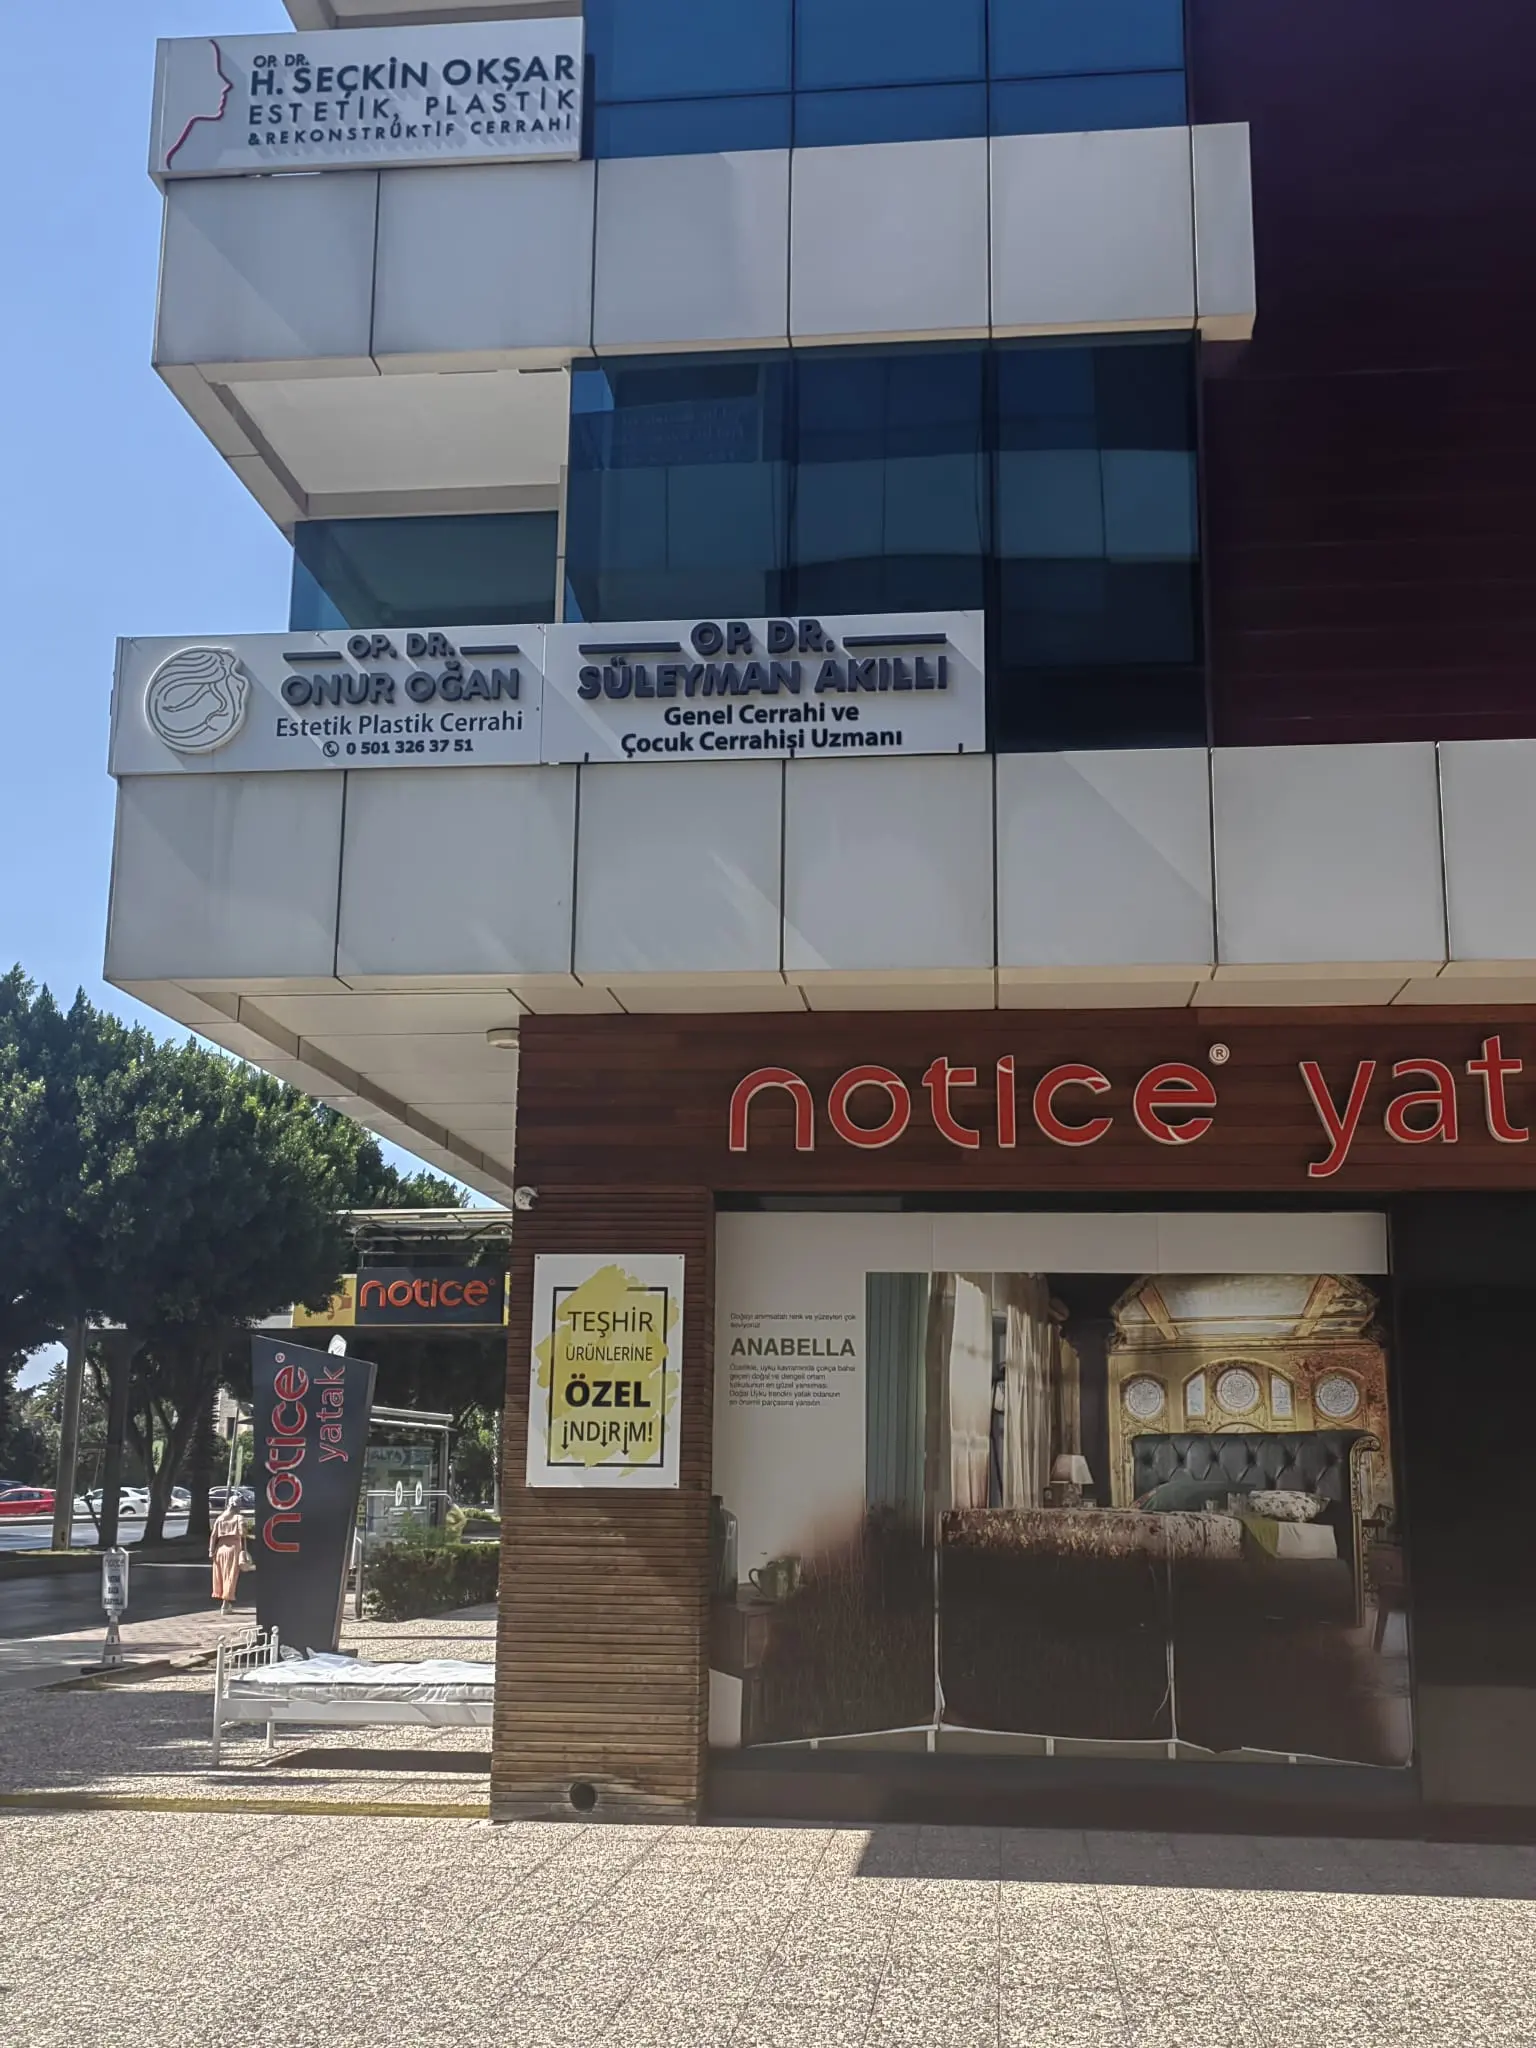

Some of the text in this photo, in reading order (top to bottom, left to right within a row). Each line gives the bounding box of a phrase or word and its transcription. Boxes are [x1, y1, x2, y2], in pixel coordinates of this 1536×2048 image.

[284, 53, 310, 67] DR.
[250, 54, 576, 98] H. SEÇKİN OKŞAR
[347, 632, 455, 659] OP. DR.
[767, 618, 835, 654] DR.
[281, 660, 520, 706] ONUR OĞAN
[577, 655, 948, 699] SÜLEYMAN AKILLI
[276, 709, 523, 737] Estetik Plastik Cerrahi
[664, 701, 860, 726] Genel Cerrahi ve
[346, 739, 473, 755] 0 501 326 37 51
[621, 731, 694, 758] Çocuk
[811, 729, 903, 747] Uzmanı
[1299, 1035, 1529, 1178] yat
[567, 1307, 653, 1337] TEŞHİR
[565, 1344, 653, 1362] ÜRÜNLERİNE
[731, 1338, 856, 1356] ANABELLA
[565, 1373, 651, 1408] ÖZEL
[313, 1365, 348, 1463] yatak
[262, 1365, 309, 1552] notice
